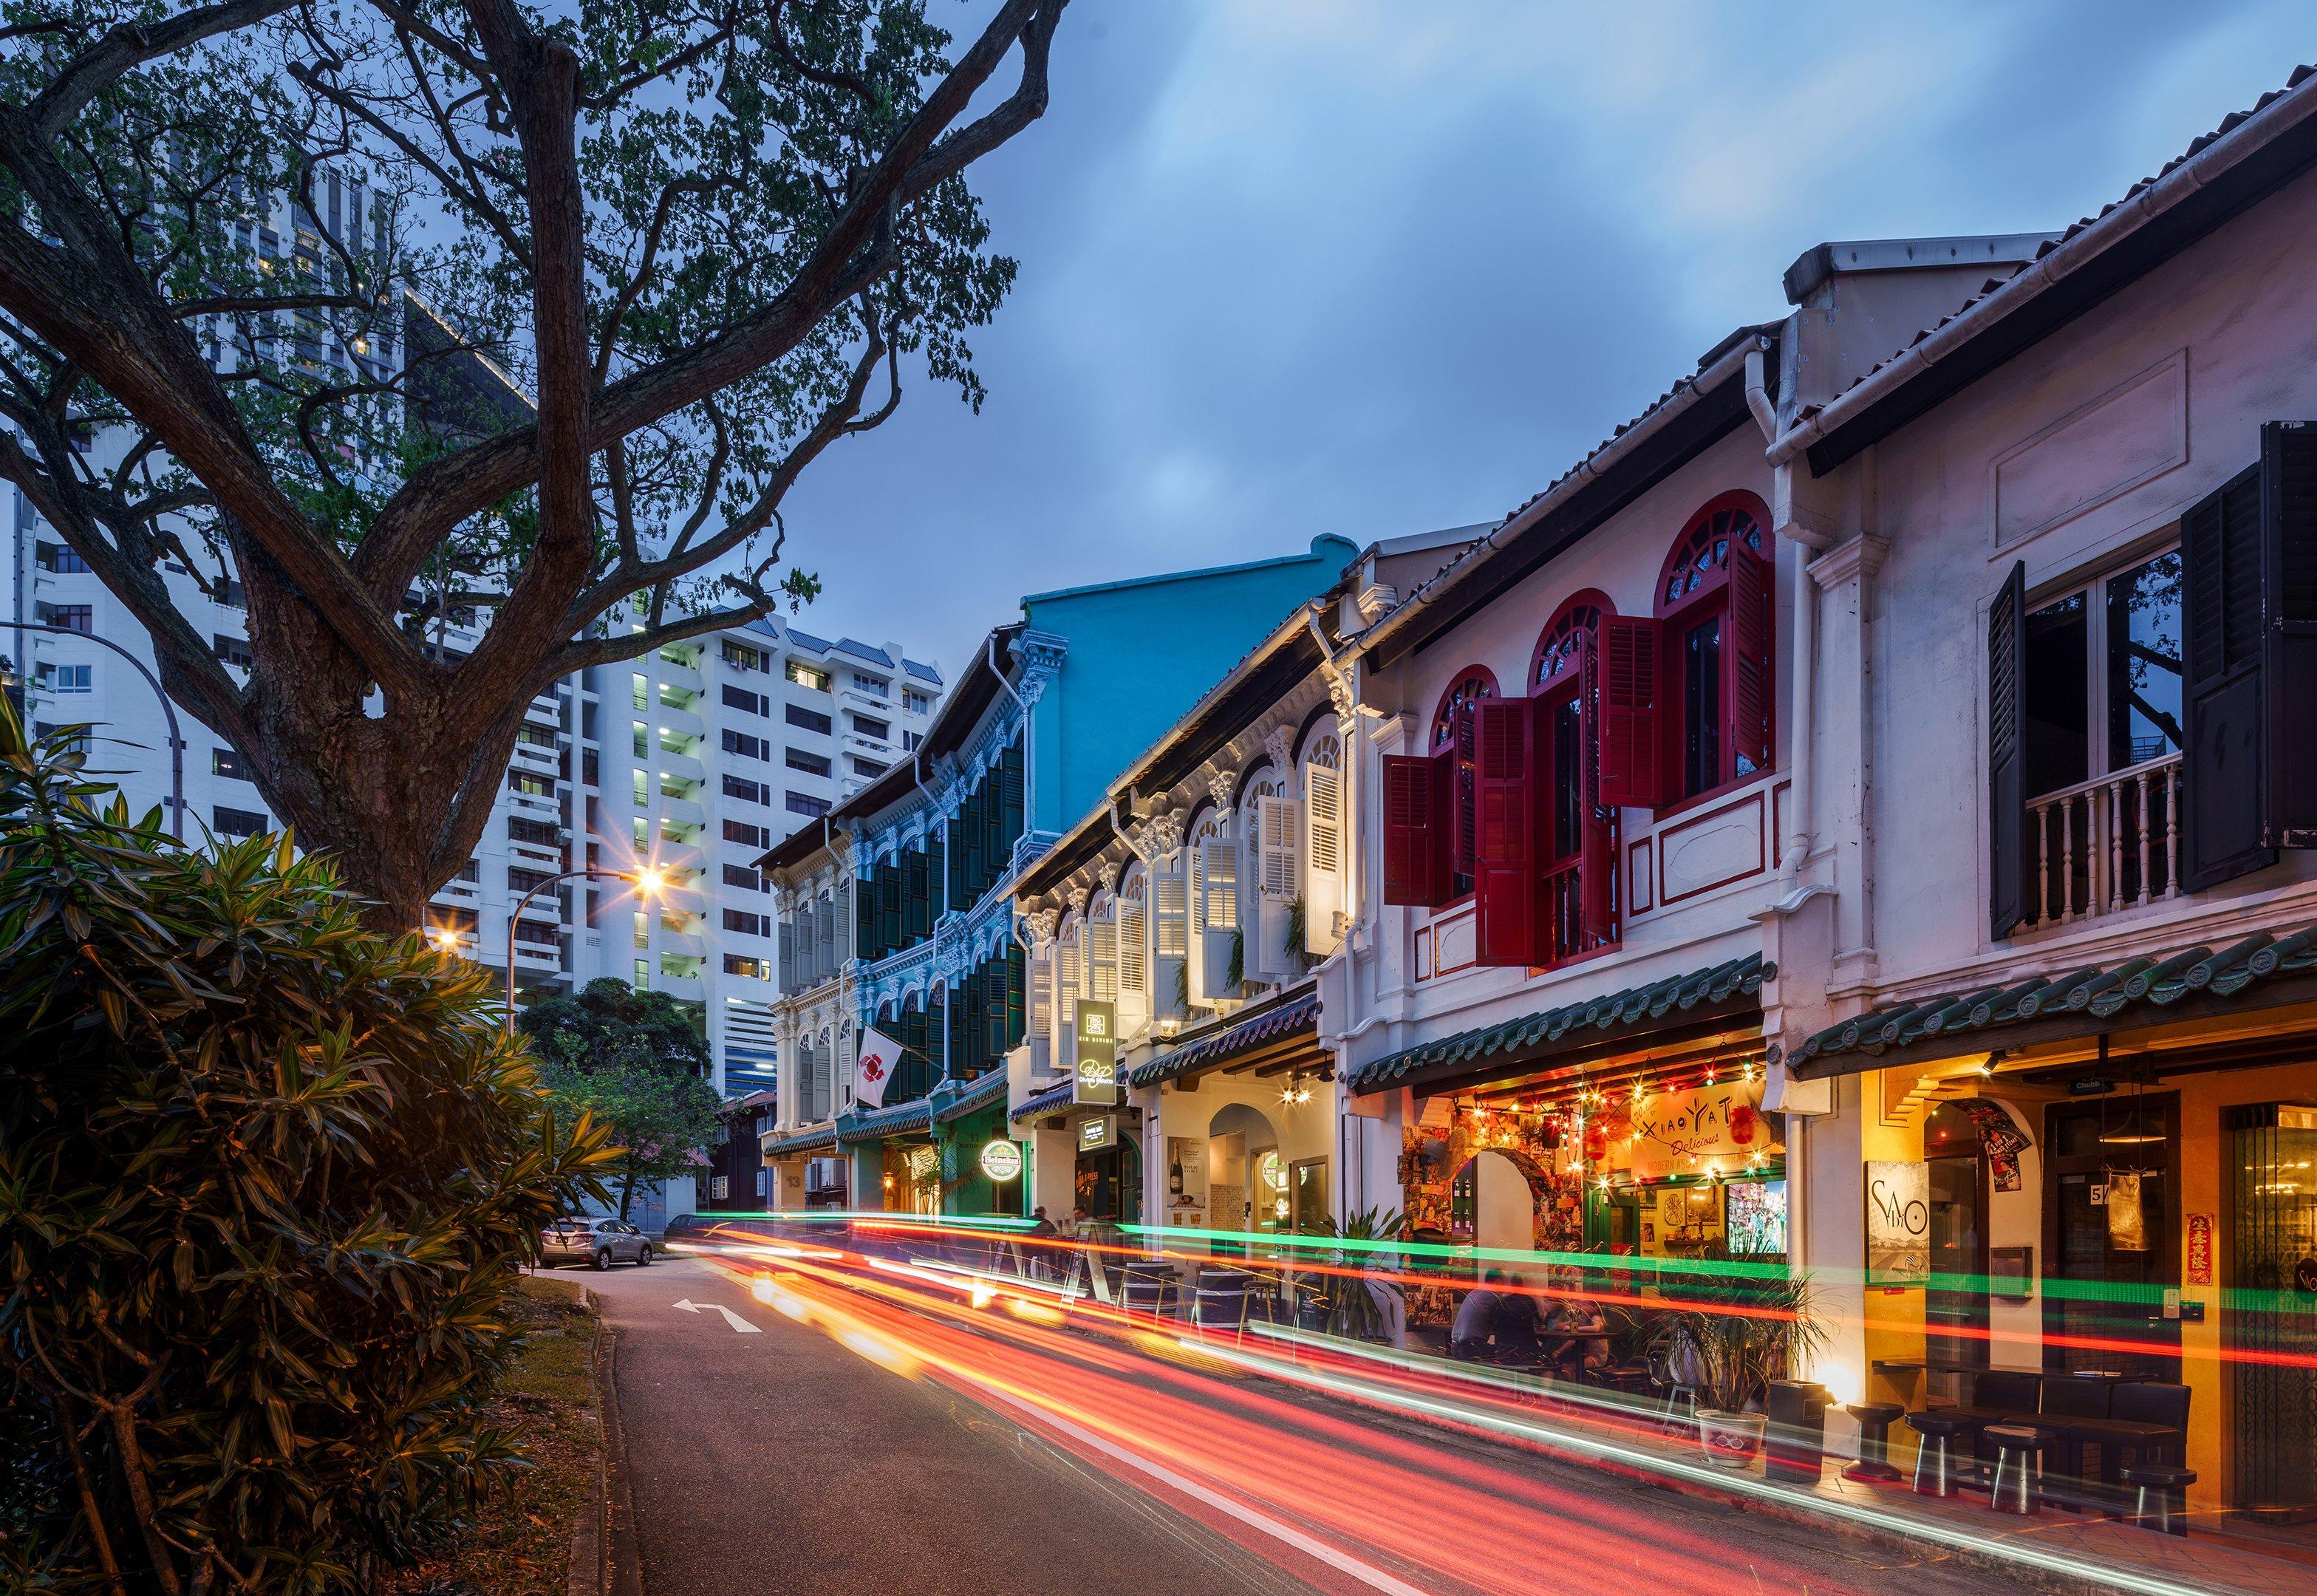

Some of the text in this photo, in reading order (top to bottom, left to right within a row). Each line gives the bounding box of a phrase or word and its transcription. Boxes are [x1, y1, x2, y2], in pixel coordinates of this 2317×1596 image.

[2076, 1080, 2101, 1089] Chubb
[970, 1133, 979, 1142] 11
[1671, 1133, 1720, 1156] Delicious
[1994, 1139, 2004, 1147] FOR
[1648, 1160, 1674, 1171] MODERN
[787, 1176, 800, 1188] 13
